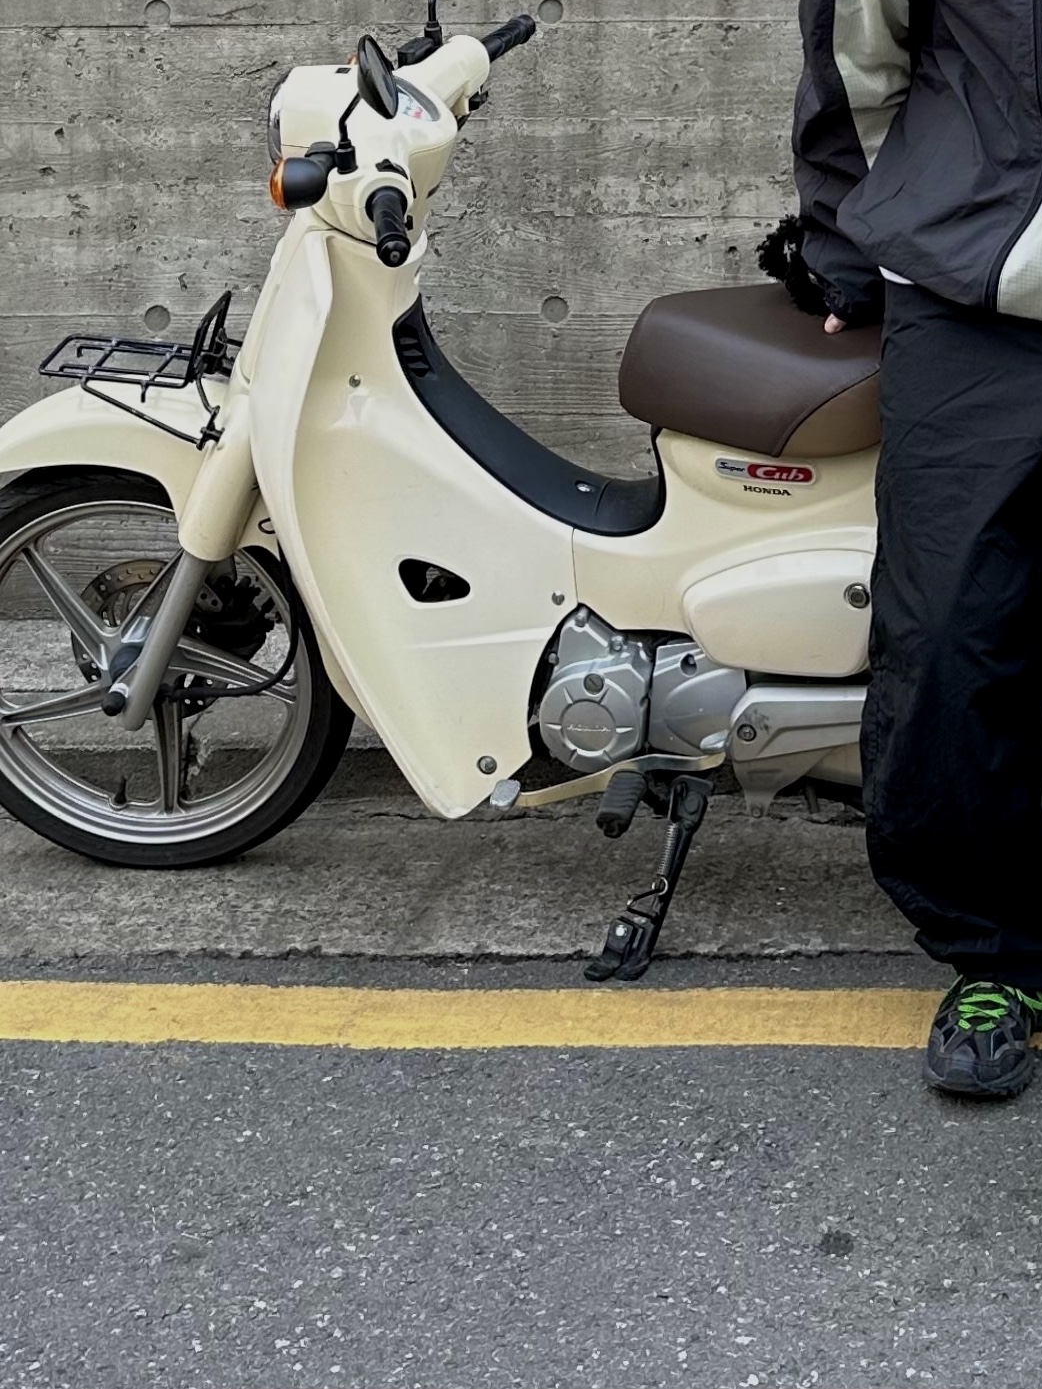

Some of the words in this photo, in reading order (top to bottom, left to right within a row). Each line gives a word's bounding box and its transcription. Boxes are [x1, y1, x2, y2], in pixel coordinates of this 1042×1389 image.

[718, 461, 746, 472] Super
[755, 466, 805, 480] Cub
[743, 484, 792, 496] HONDA
